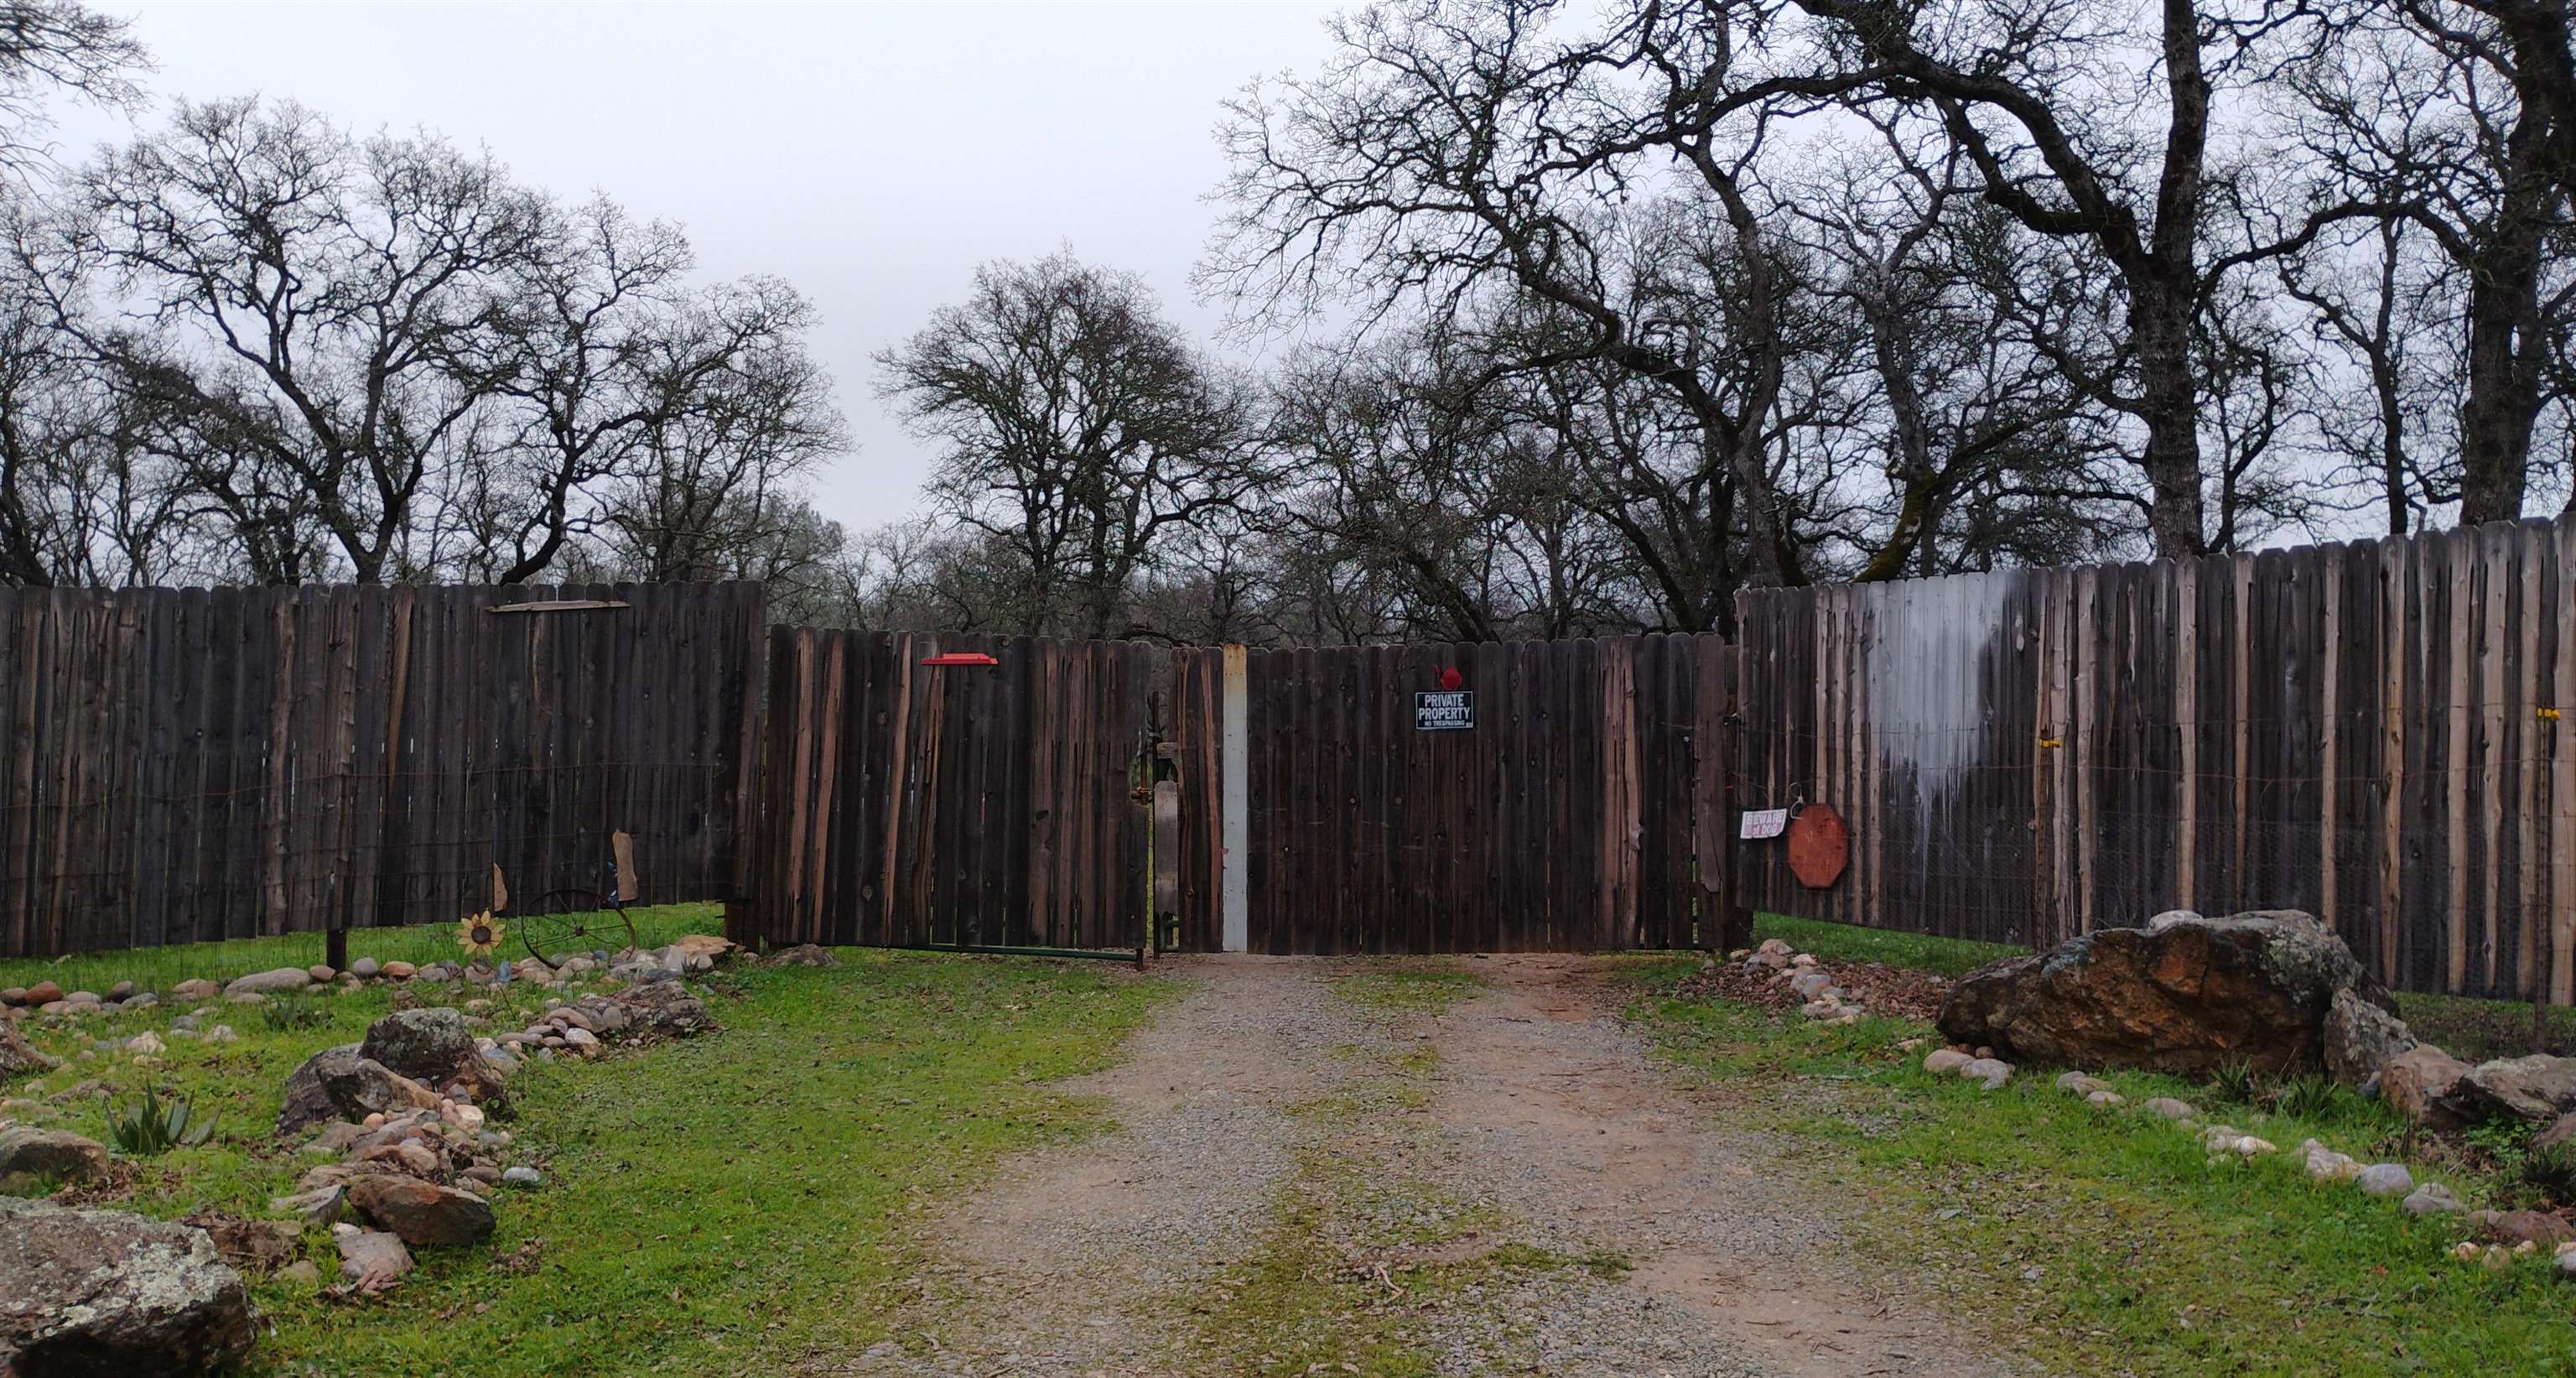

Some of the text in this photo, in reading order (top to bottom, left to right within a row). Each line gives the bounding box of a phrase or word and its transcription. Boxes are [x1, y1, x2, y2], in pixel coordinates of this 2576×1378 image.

[1425, 694, 1464, 707] PRIVATE
[1418, 707, 1470, 720] PROPERTY
[1746, 812, 1784, 825] BEWARE
